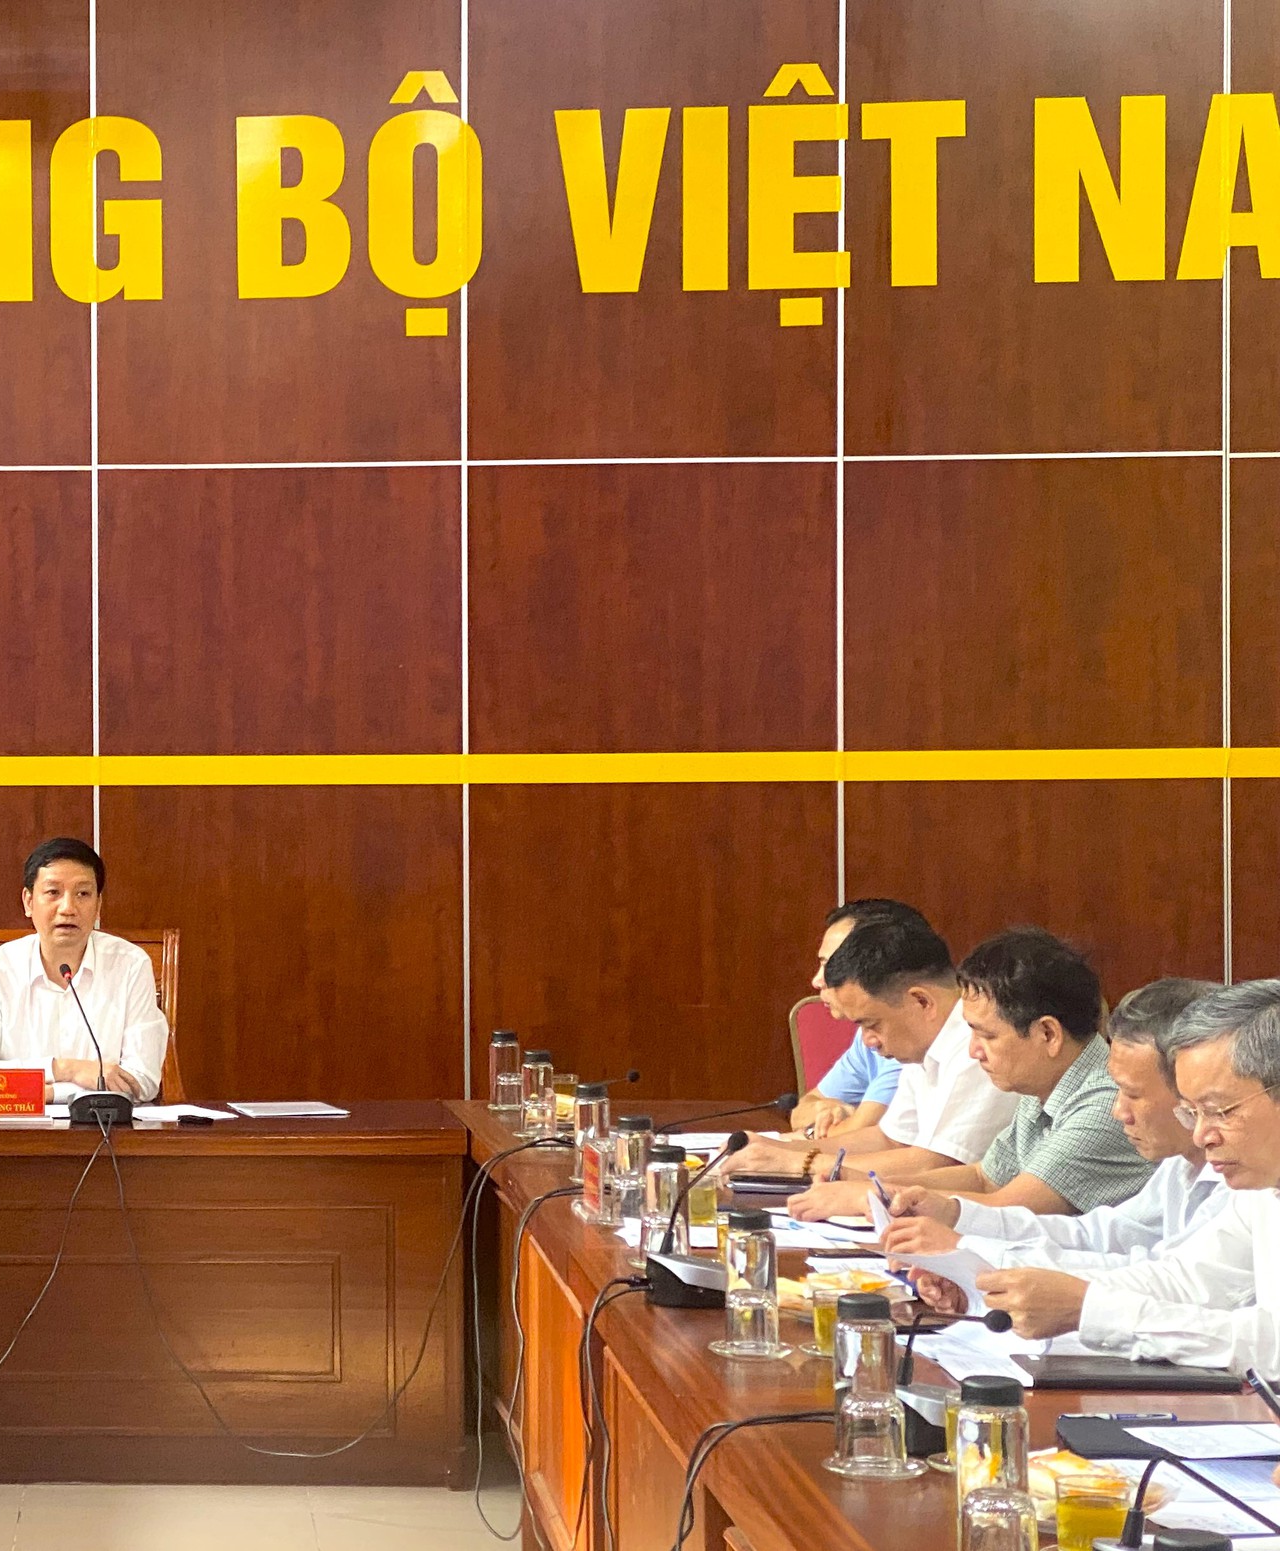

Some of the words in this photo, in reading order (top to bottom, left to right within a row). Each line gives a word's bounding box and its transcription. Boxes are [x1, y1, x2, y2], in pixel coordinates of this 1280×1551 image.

[235, 70, 483, 337] BỘ
[554, 63, 966, 328] VIỆT
[13, 1101, 35, 1112] THÁI
